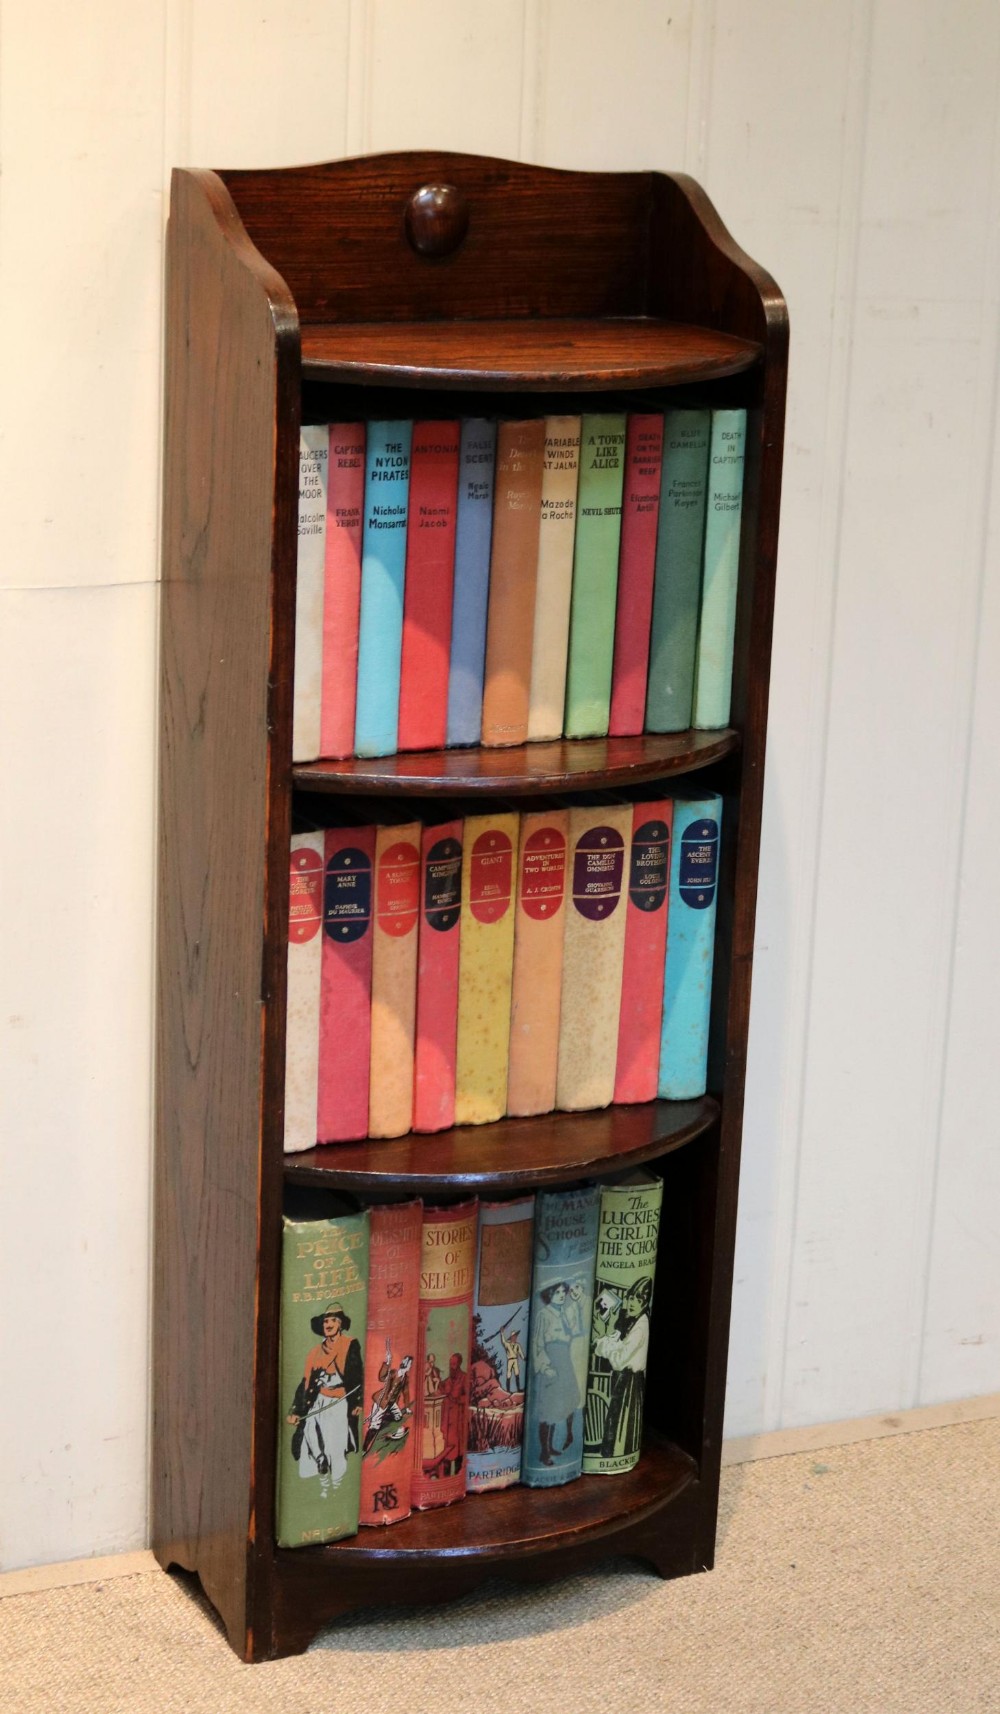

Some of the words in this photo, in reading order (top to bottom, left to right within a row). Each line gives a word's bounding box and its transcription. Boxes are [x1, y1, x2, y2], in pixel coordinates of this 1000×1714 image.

[588, 436, 596, 446] A
[598, 434, 625, 445] TOWN
[722, 432, 742, 440] DEATH
[386, 443, 402, 453] THE
[415, 444, 459, 454] ANTONIA
[596, 447, 618, 457] LIKE
[466, 454, 493, 464] SCENT
[548, 450, 574, 458] WINDS
[338, 458, 361, 468] REBEL
[376, 456, 408, 468] NYLON
[554, 461, 577, 470] JALNA
[590, 458, 620, 470] ALICE
[301, 464, 322, 473] OVER
[372, 470, 409, 481] PIRATES
[304, 476, 318, 486] THE
[299, 489, 322, 499] MOOR
[541, 500, 564, 509] Mazo
[564, 500, 574, 508] de
[336, 508, 360, 517] FRANK
[373, 506, 406, 516] Nicholas
[420, 506, 449, 516] Naomi
[550, 511, 573, 520] Roche
[582, 508, 603, 516] NEVIL
[419, 519, 448, 528] Jacob
[481, 856, 503, 865] GIANT
[628, 1196, 648, 1210] The
[602, 1208, 660, 1226] LUCKIES
[426, 1224, 474, 1246] STORIES
[606, 1226, 644, 1240] GIRL
[646, 1224, 658, 1238] IN
[600, 1241, 622, 1256] THE
[444, 1250, 462, 1265] OF
[313, 1256, 337, 1270] OF
[600, 1261, 636, 1269] ANGELA
[304, 1266, 360, 1290] LIFE
[599, 1456, 636, 1468] BLACKIE
